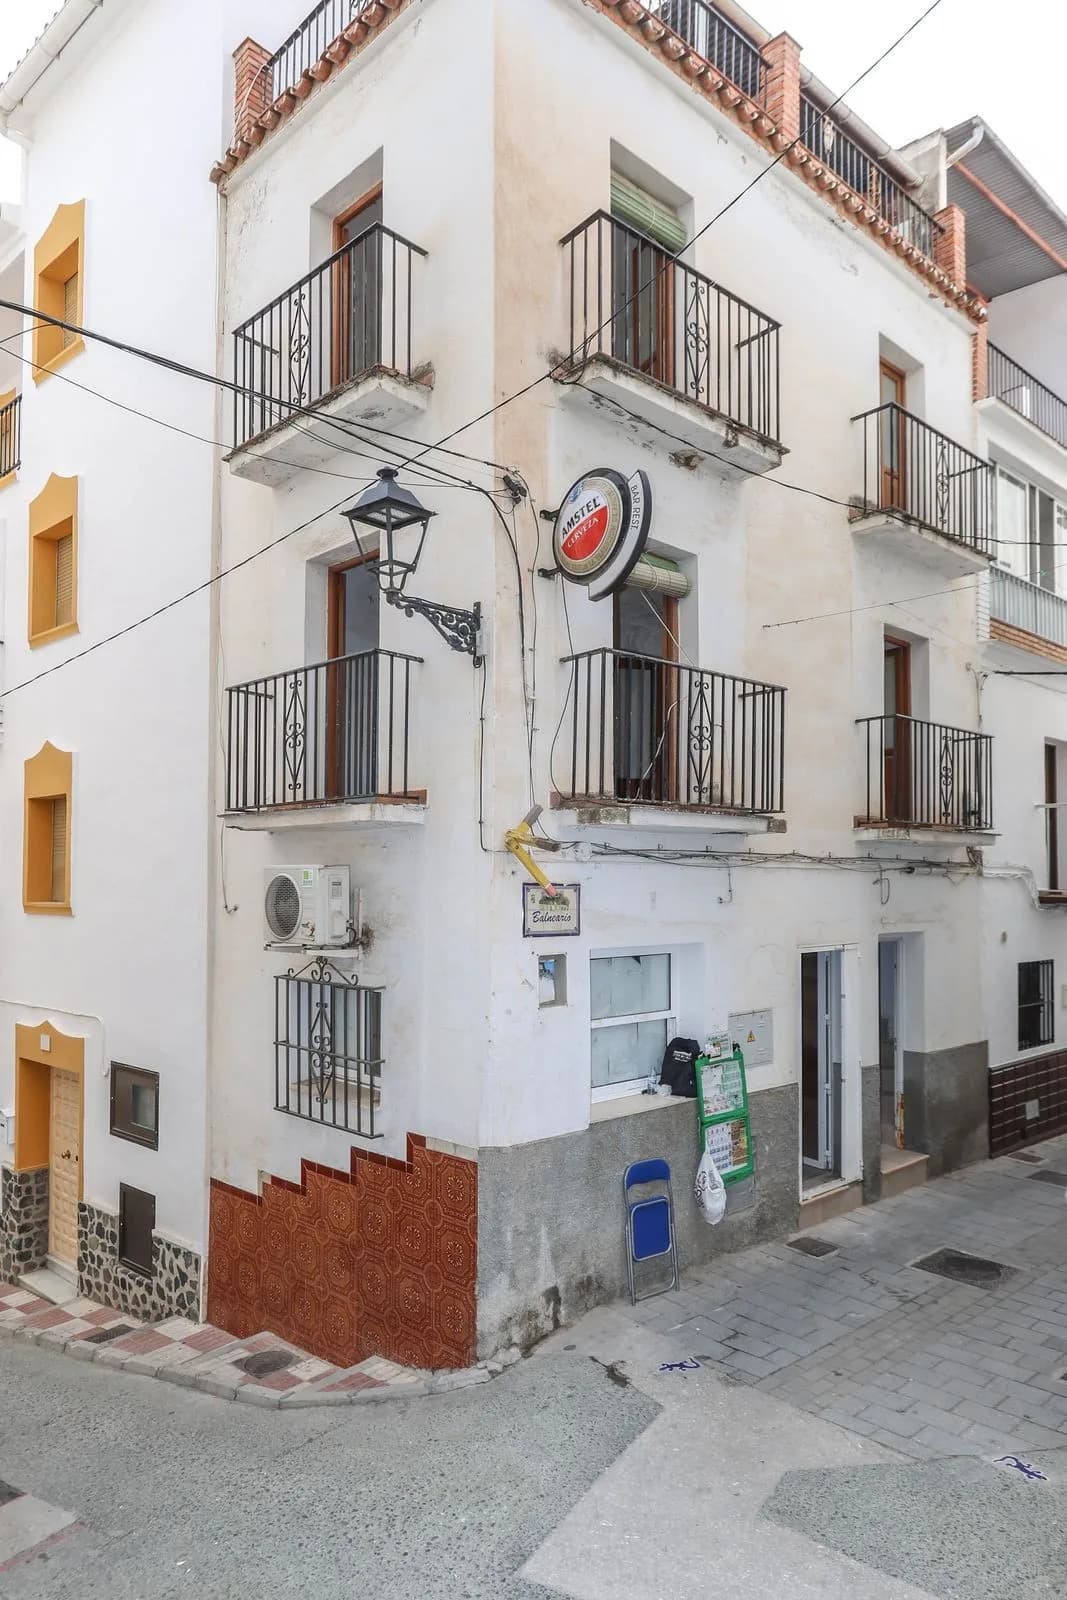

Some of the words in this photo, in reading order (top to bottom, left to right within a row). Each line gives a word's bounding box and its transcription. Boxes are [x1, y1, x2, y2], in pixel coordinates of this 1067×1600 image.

[630, 485, 640, 504] BAR
[562, 498, 601, 540] AMSTEL
[567, 517, 599, 548] CERVEZA
[532, 911, 571, 923] Balneario
